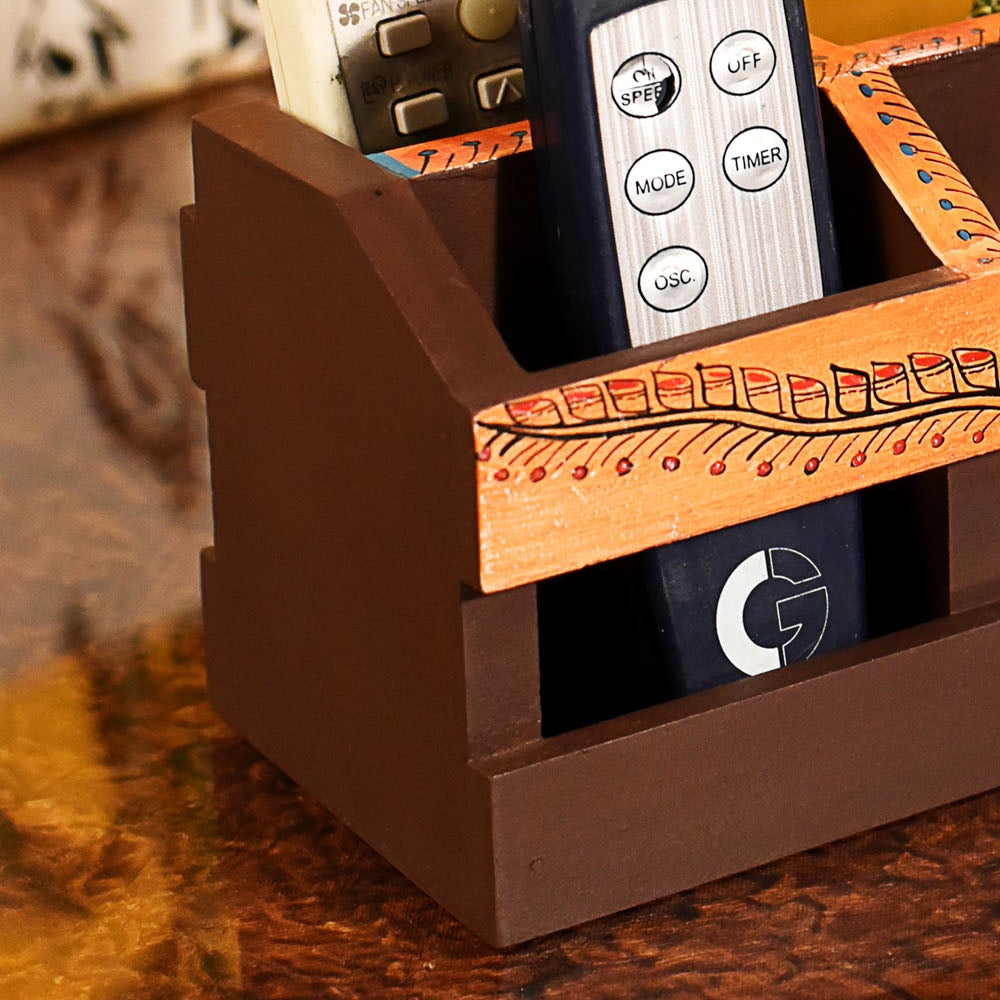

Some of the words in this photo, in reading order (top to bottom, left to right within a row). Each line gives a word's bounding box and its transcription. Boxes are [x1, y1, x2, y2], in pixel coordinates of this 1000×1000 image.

[727, 52, 761, 74] OFF
[731, 146, 782, 172] TIMER
[635, 169, 687, 196] MODE
[654, 269, 696, 291] OSC.
